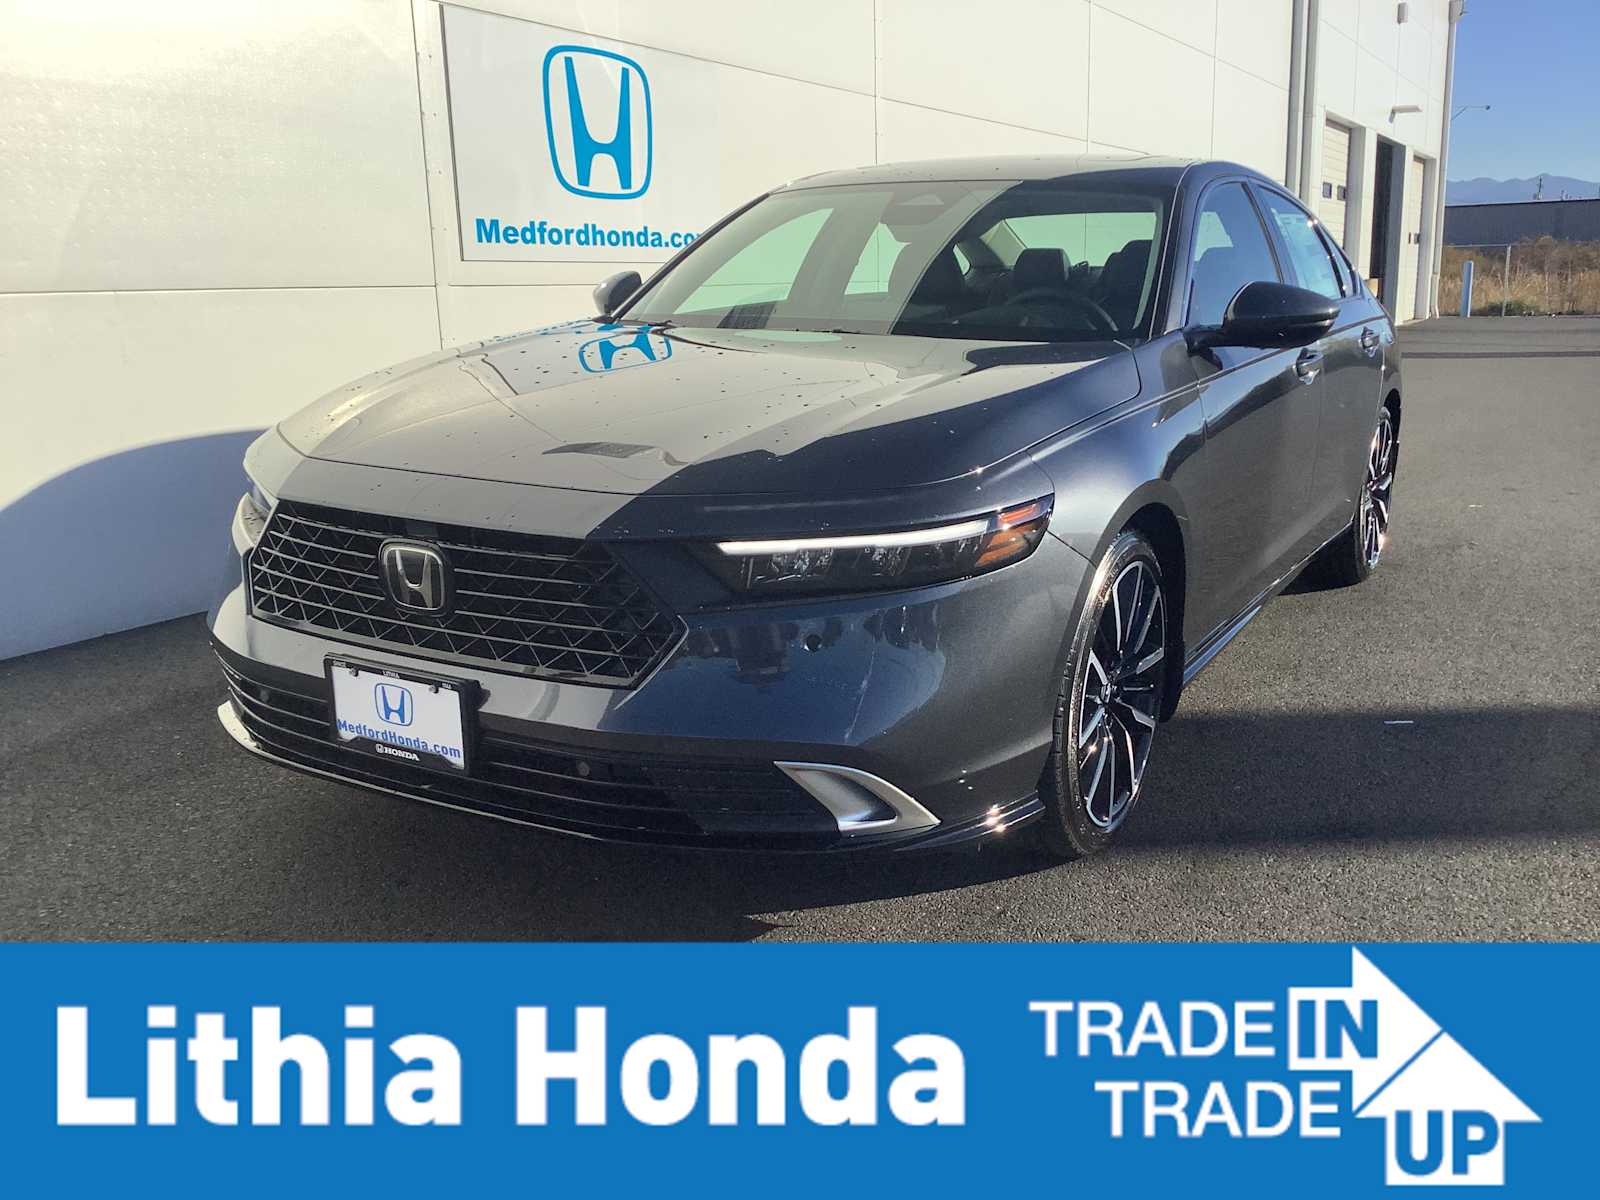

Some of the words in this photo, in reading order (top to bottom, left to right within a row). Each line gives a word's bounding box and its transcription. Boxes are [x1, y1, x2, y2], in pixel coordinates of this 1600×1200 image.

[475, 217, 705, 248] Medfordhonda.co
[337, 719, 461, 759] MedfordHonda.com
[384, 747, 419, 760] HONDA
